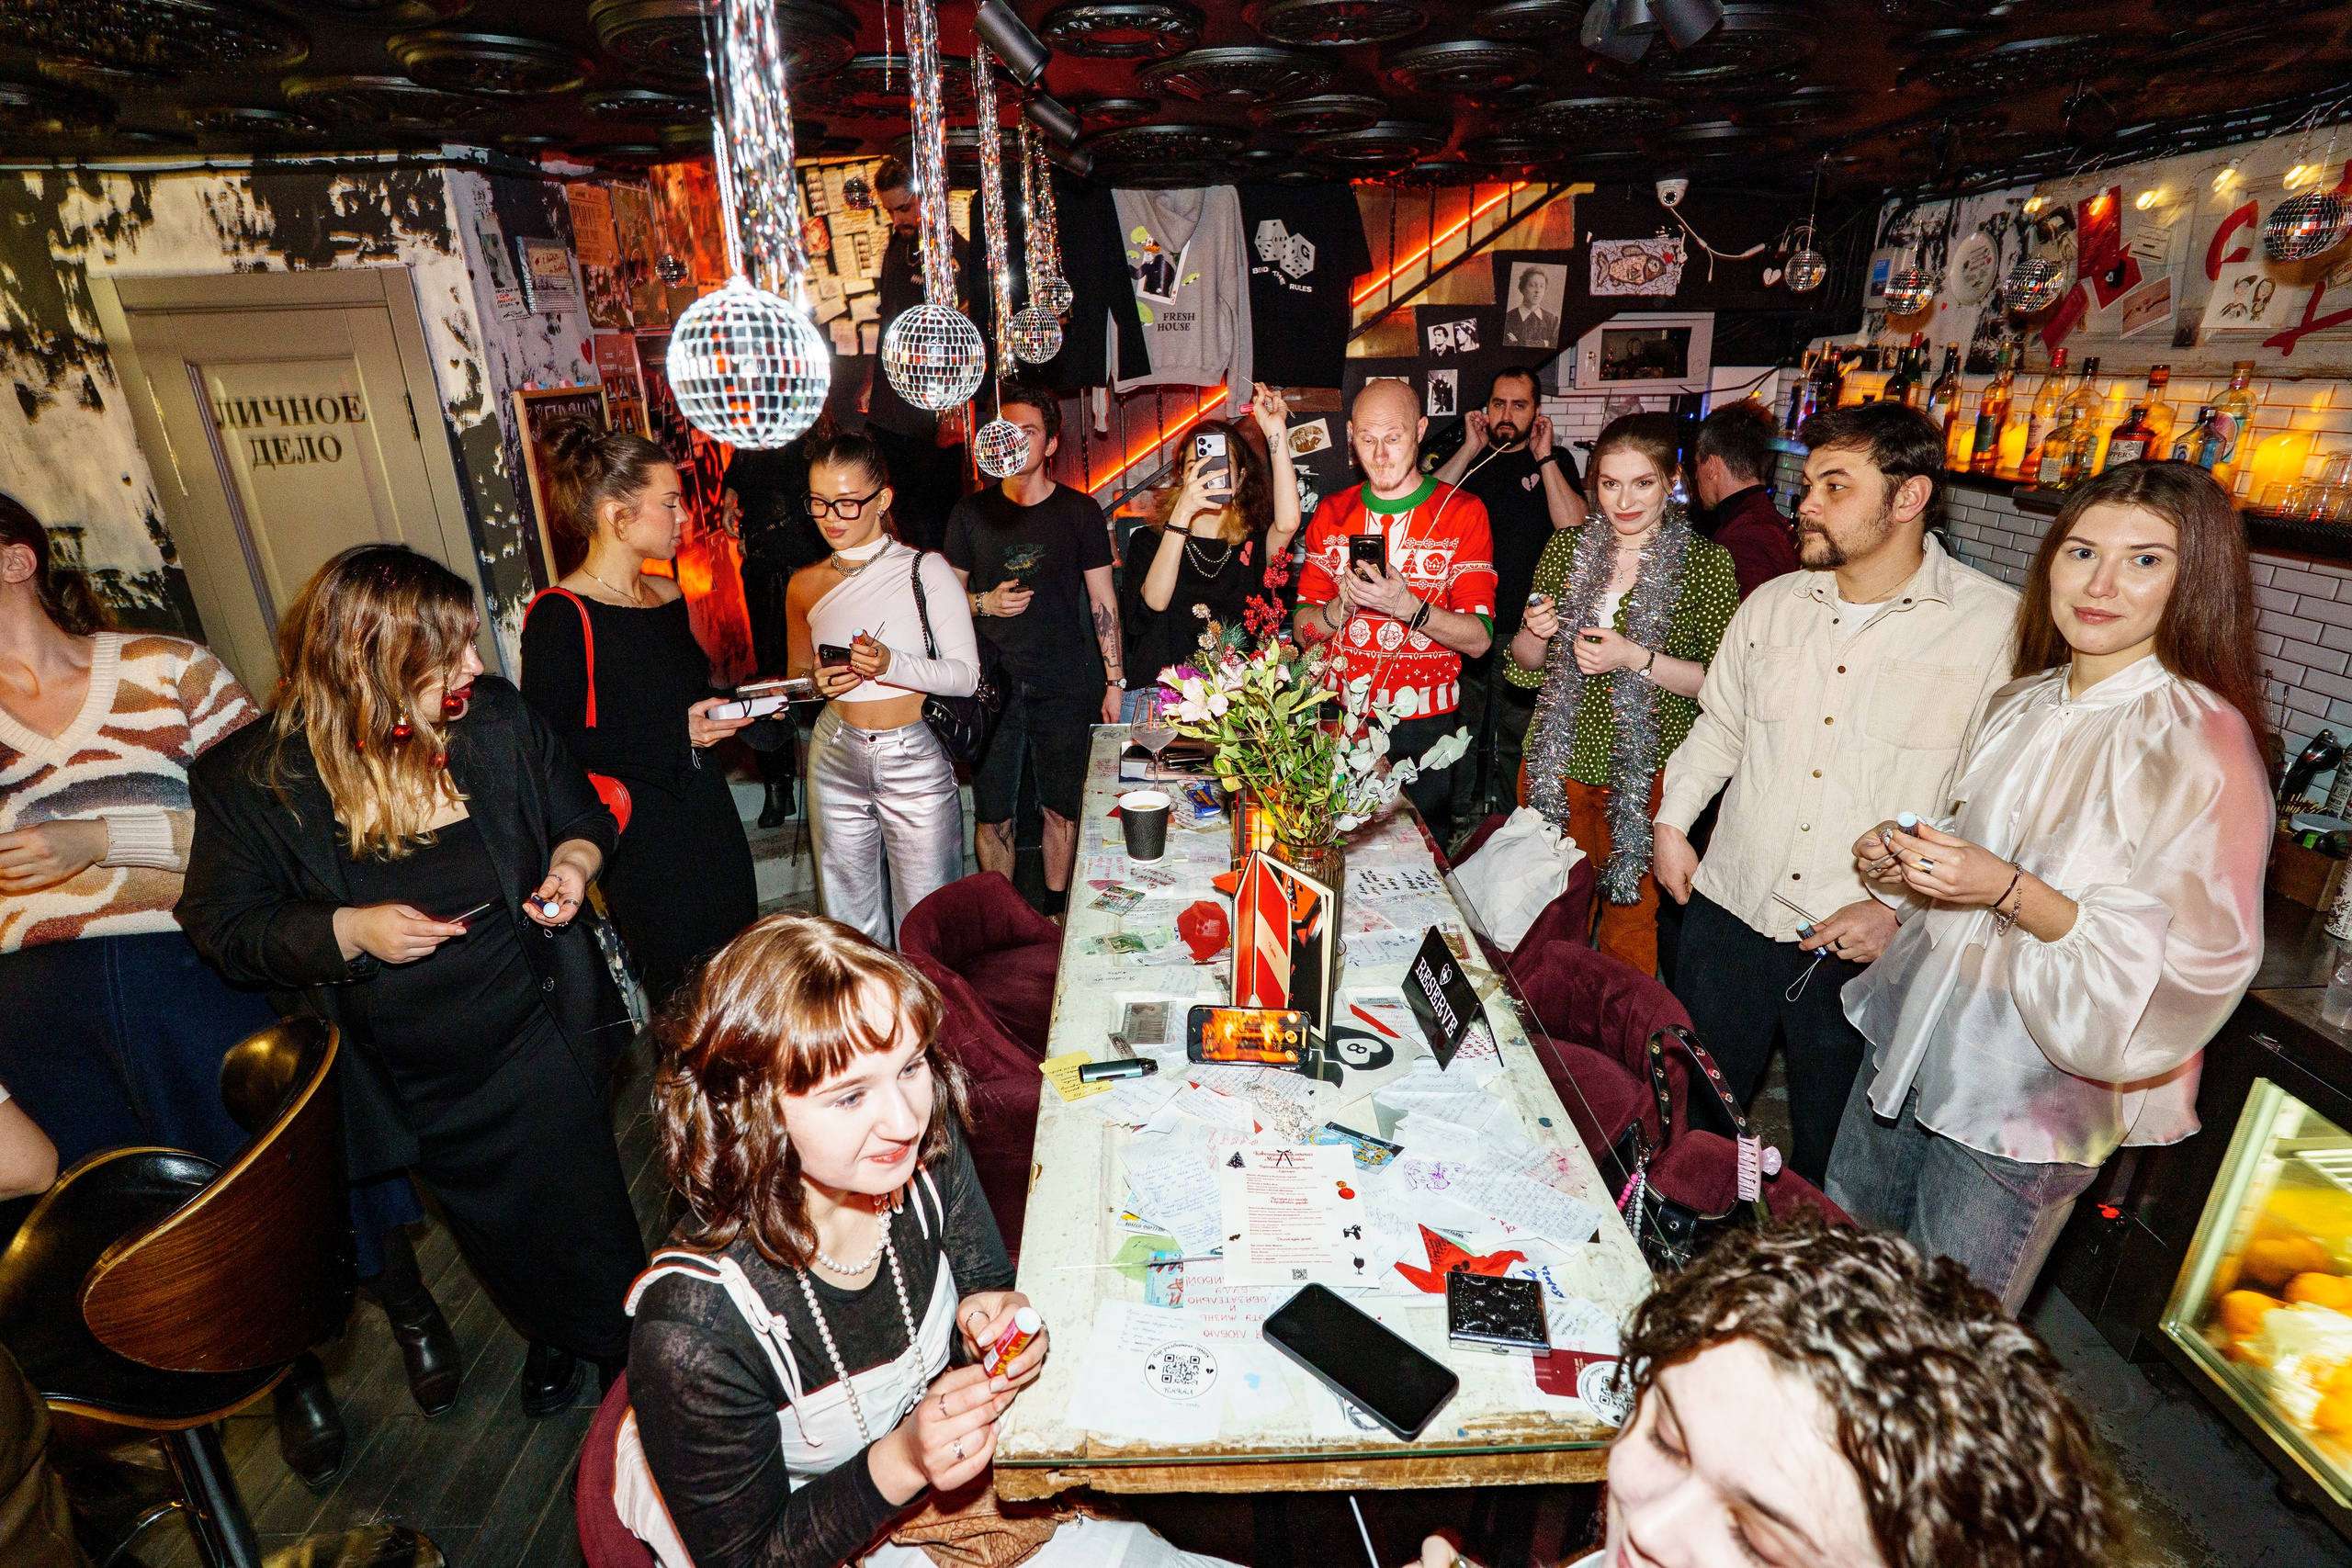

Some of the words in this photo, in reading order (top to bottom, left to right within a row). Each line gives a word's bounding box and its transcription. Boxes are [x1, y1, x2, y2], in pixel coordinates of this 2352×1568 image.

[1289, 283, 1313, 293] RULES
[1163, 312, 1195, 321] FRESH
[1157, 322, 1191, 332] HOUSE
[215, 392, 367, 430] ЛИЧНОЕ
[247, 434, 343, 471] ДЕЛО
[1415, 957, 1458, 1038] RESERVE
[1185, 1276, 1225, 1287] ИВОЙ!
[1215, 1286, 1249, 1294] БУДУ
[1187, 1295, 1267, 1304] ОБЯЗАТЕЛЬНО
[1199, 1314, 1238, 1322] ЖИЗНЬ
[1245, 1314, 1267, 1322] ЭТУ
[1203, 1329, 1246, 1339] ЛЮБЛЮ
[1255, 1329, 1263, 1339] Я
